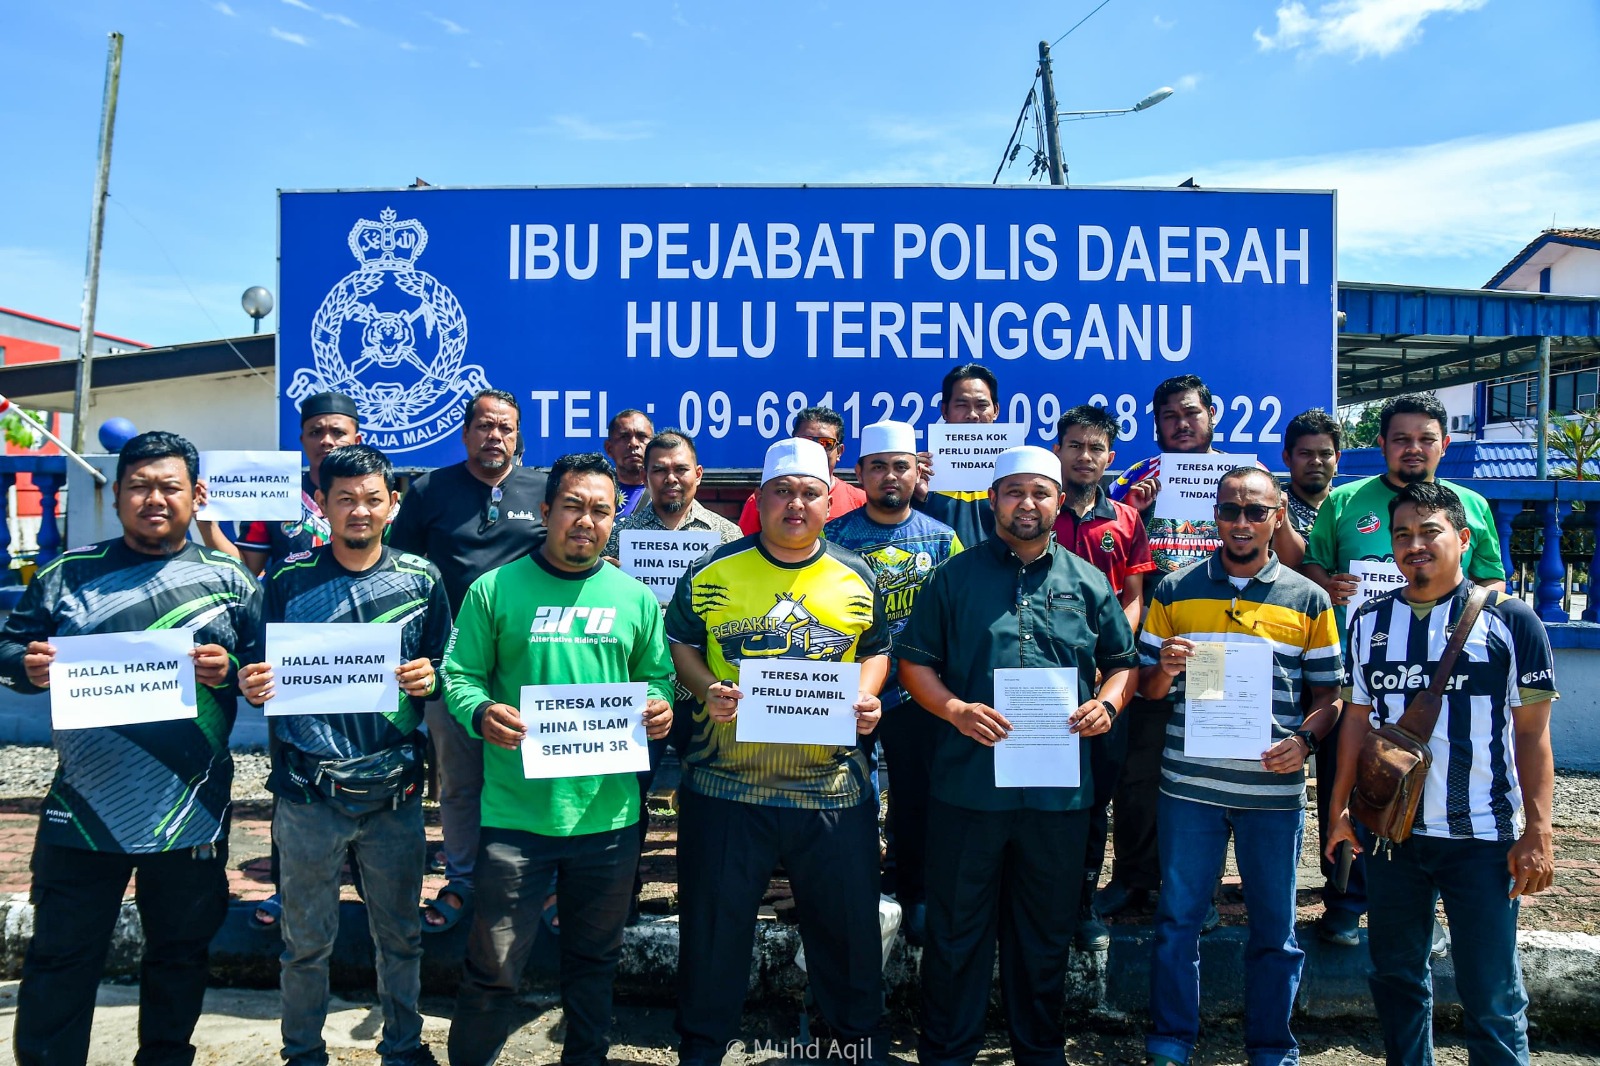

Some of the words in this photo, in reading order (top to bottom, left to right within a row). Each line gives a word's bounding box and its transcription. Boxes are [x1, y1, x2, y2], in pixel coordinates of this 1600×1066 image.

[509, 223, 599, 280] IBU
[620, 222, 875, 280] PEJABAT
[894, 222, 1058, 282] POLIS
[1078, 225, 1309, 285] DAERAH
[626, 301, 776, 360] HULU
[795, 301, 1192, 363] TERENGGANU
[945, 433, 984, 441] TERESA
[986, 433, 1008, 441] KOK
[938, 447, 971, 455] PERLU
[950, 461, 996, 469] TINDAKA
[1176, 463, 1214, 471] TERESA
[209, 475, 246, 483] HALAL
[250, 475, 289, 483] HARAM
[1168, 476, 1200, 485] PERLU
[210, 490, 257, 498] URUSAN
[260, 490, 289, 498] KAMI
[1179, 491, 1217, 499] TINDAK
[630, 541, 679, 551] TERESA
[682, 542, 709, 552] KOK
[634, 558, 665, 568] HINA
[668, 559, 694, 569] ISLA
[1361, 572, 1409, 584] TERES
[710, 616, 780, 639] BERAKIT
[530, 635, 573, 643] Alternative
[574, 636, 599, 645] Riding
[600, 636, 618, 644] Club
[282, 656, 330, 666] HALAL
[334, 654, 385, 665] HARAM
[68, 665, 119, 678] HALAL
[124, 660, 178, 674] HARAM
[282, 674, 343, 685] URUSAN
[347, 673, 383, 684] KAMI
[761, 670, 809, 681] TERESA
[812, 672, 839, 683] KOK
[70, 683, 135, 698] URUSAN
[140, 679, 178, 692] KAMI
[752, 687, 792, 697] PERLU
[795, 689, 846, 700] DIAMBIL
[534, 697, 596, 711] TERESA
[600, 696, 633, 708] KOK
[765, 705, 829, 716] TINDAKAN
[540, 721, 578, 734] HINA
[583, 717, 628, 731] ISLAM
[542, 741, 604, 756] SENTUH
[609, 740, 628, 752] 3R
